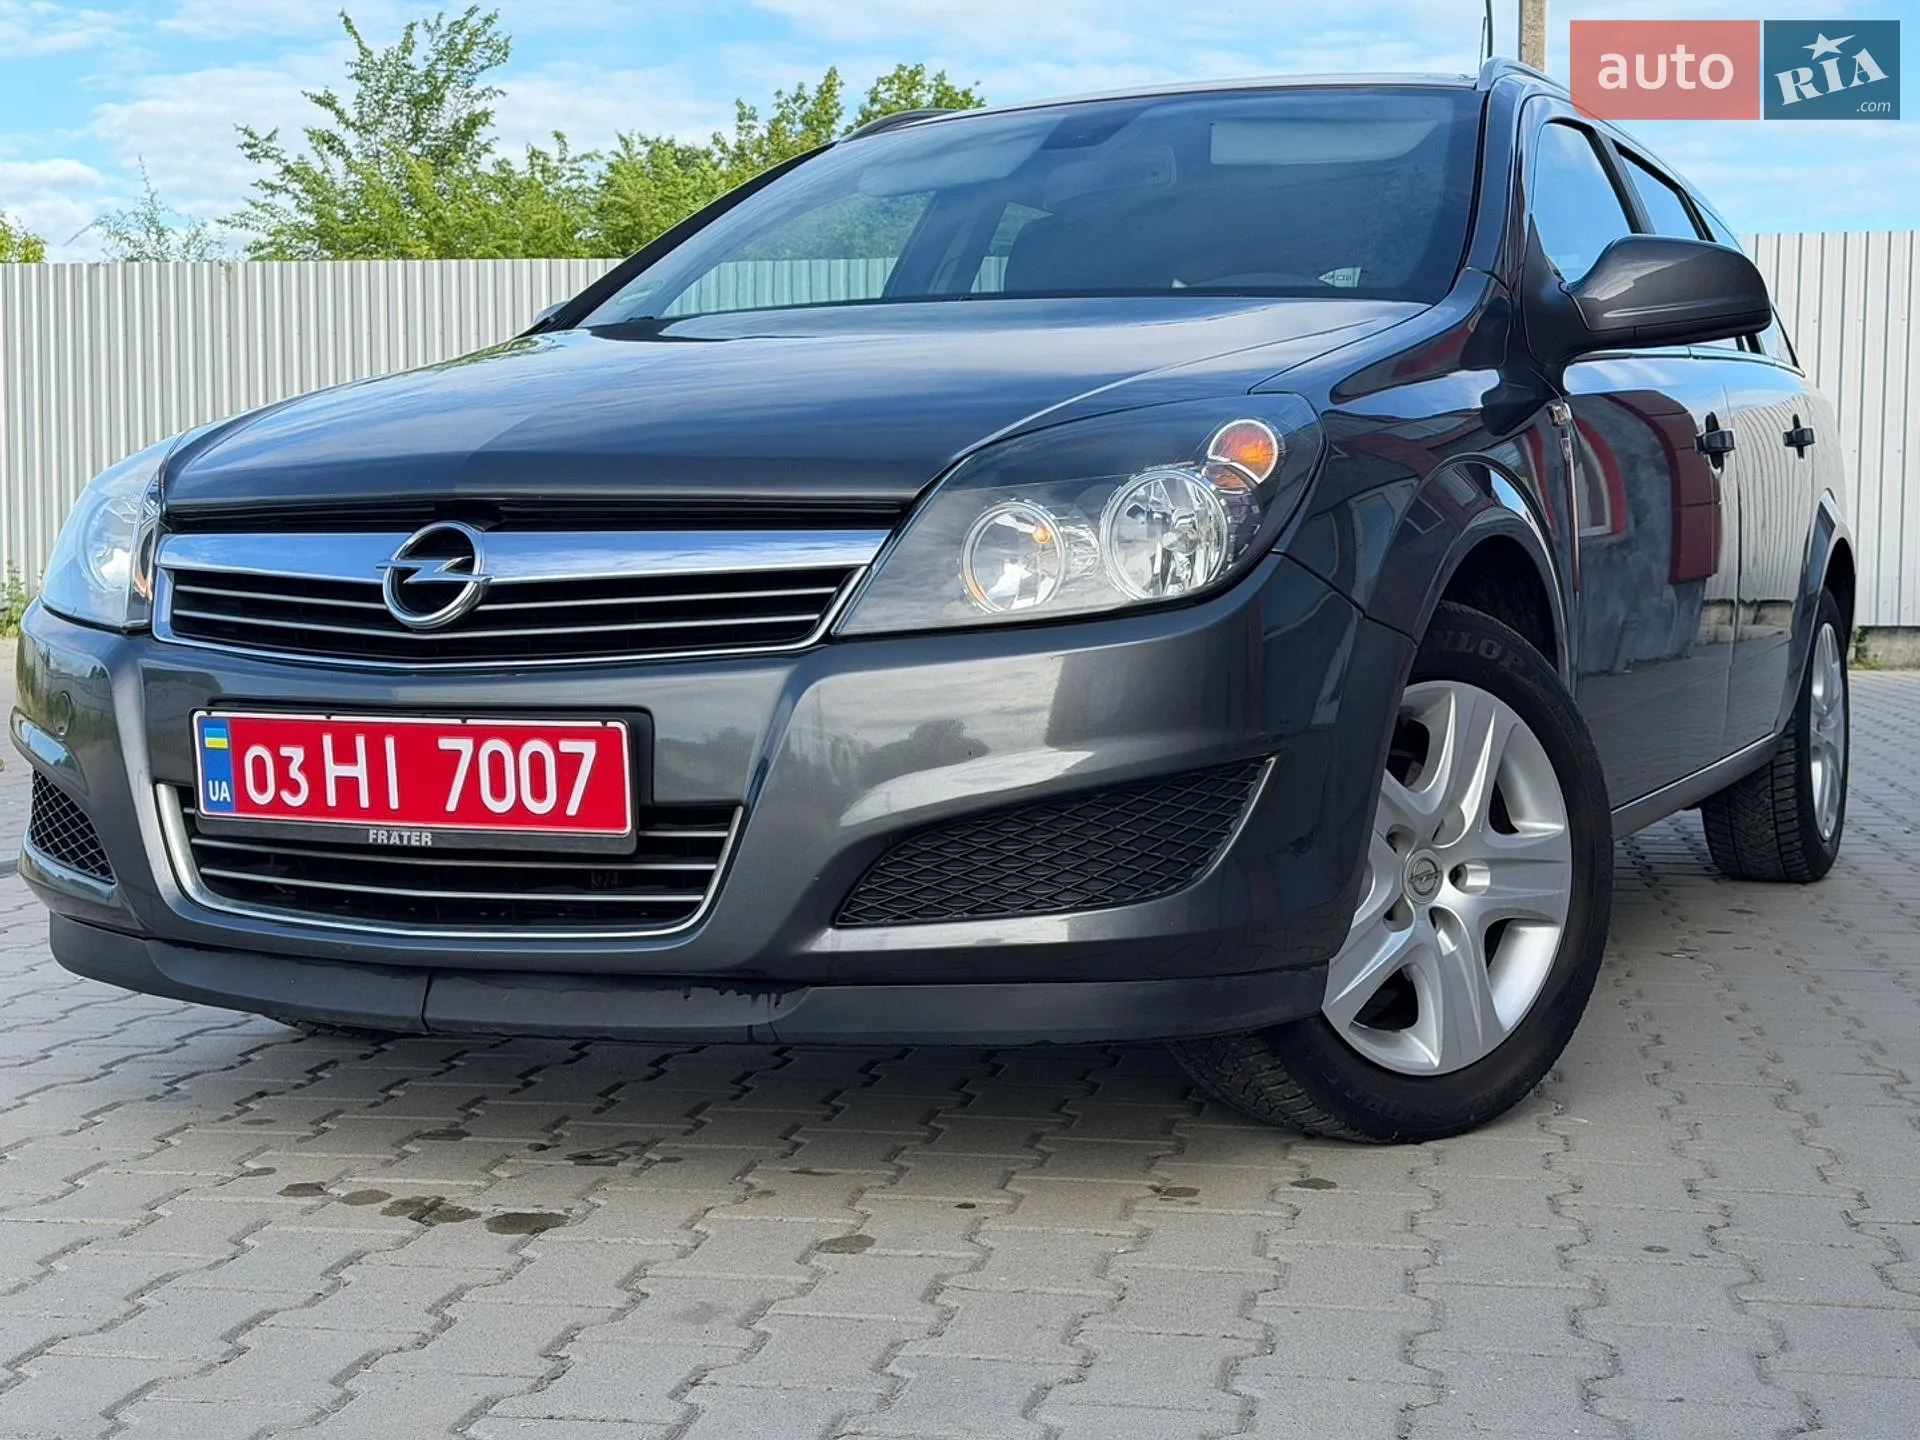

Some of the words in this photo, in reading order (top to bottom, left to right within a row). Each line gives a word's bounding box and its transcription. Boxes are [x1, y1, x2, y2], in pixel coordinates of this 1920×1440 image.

[1431, 629, 1528, 669] NLOP
[208, 780, 231, 802] UA
[438, 735, 597, 816] 7007
[369, 829, 432, 846] FRATER
